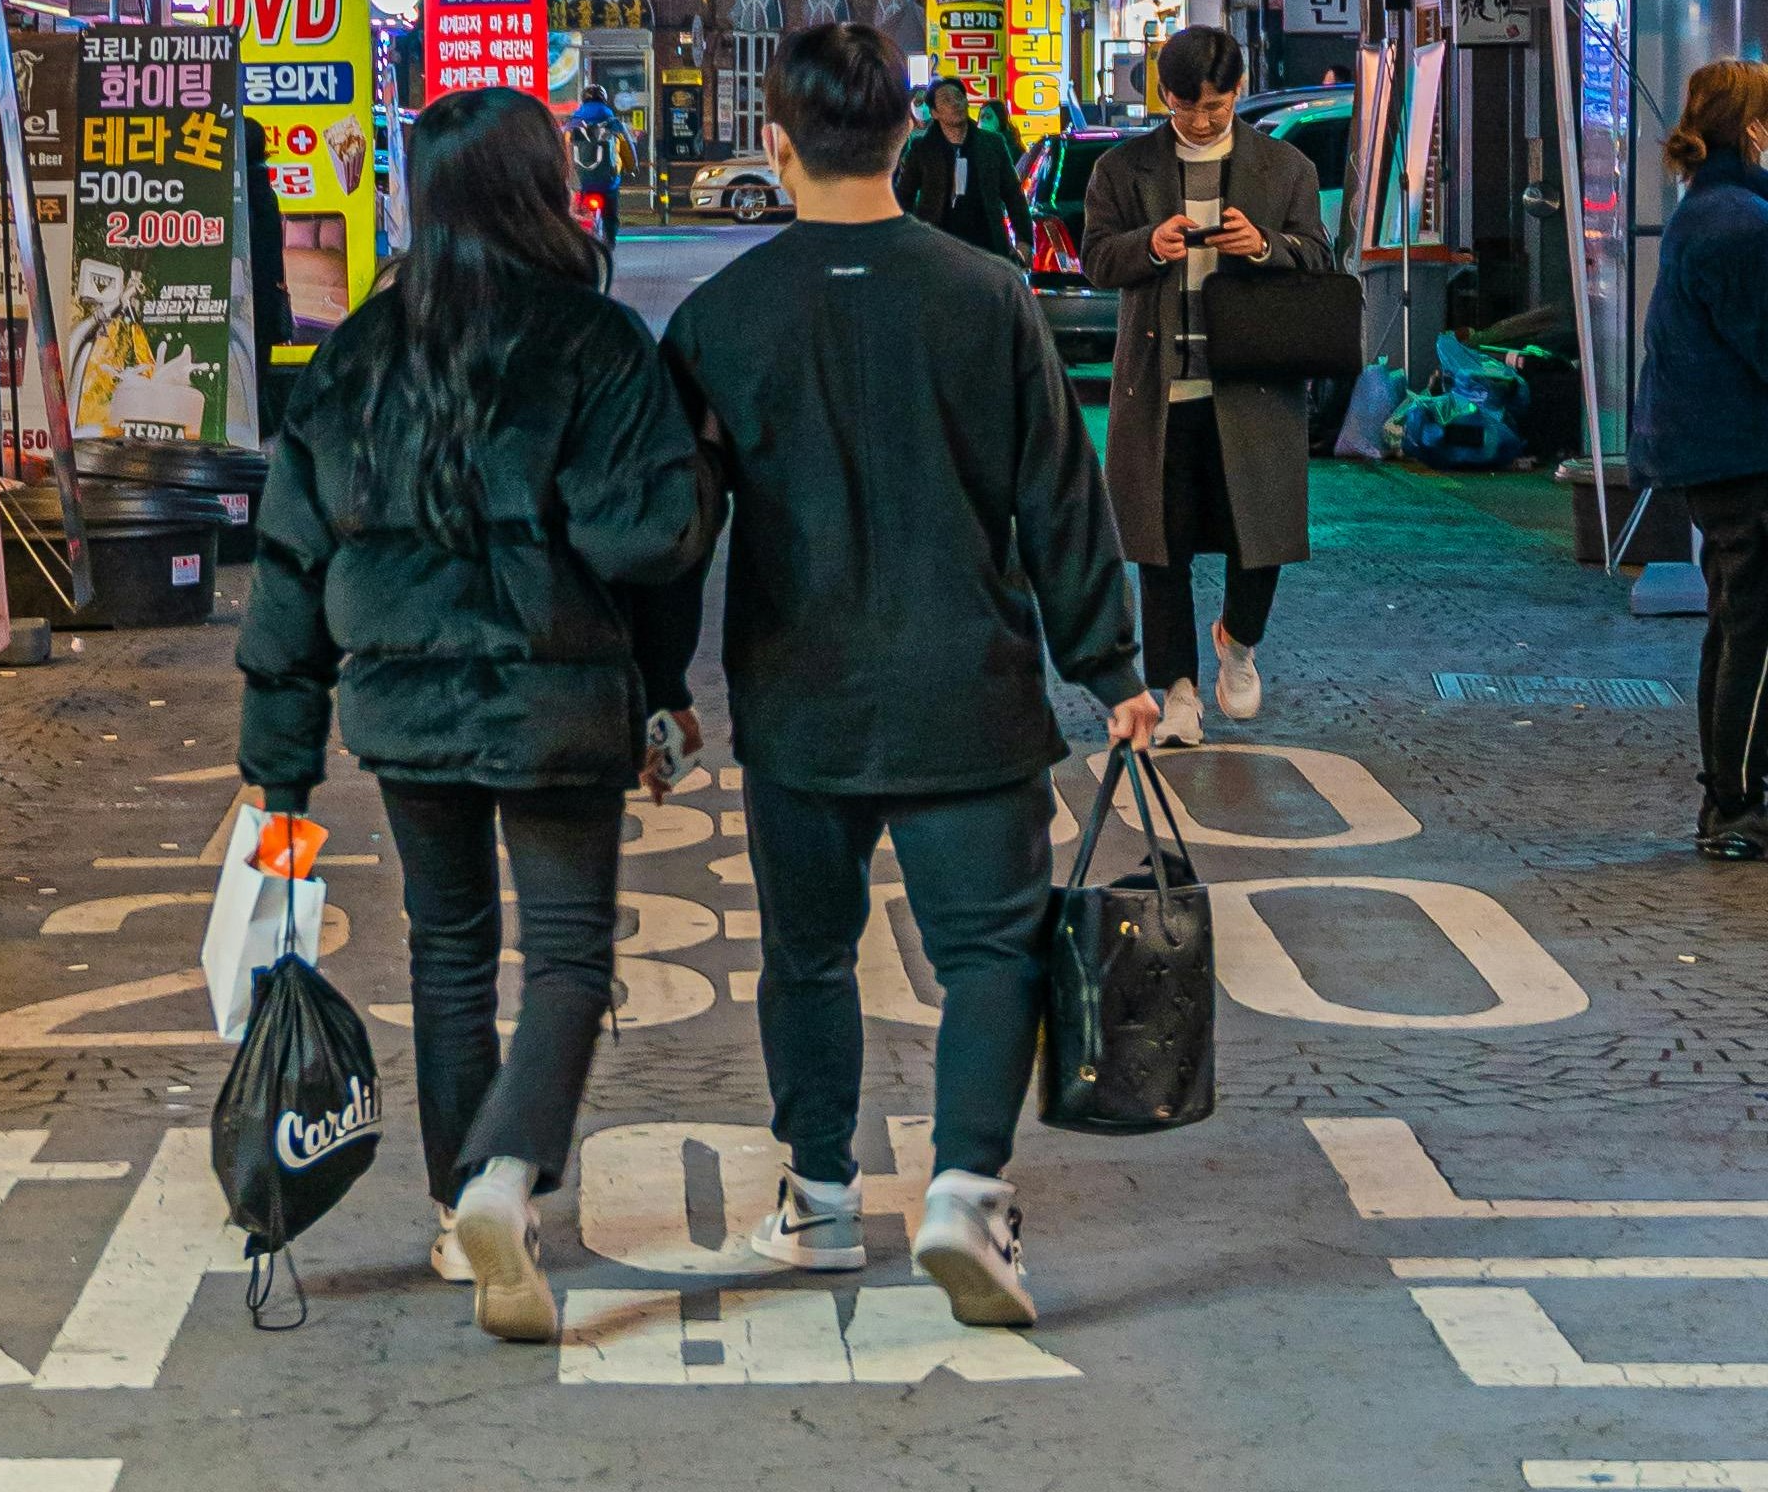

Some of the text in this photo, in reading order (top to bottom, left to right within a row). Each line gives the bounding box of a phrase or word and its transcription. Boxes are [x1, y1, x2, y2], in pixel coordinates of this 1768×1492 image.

[438, 13, 482, 36] 세계과자
[82, 34, 233, 64] 코로나 이겨내자
[438, 39, 482, 61] 인기안주
[100, 63, 213, 109] 화이팅
[242, 64, 339, 104] 동의자
[439, 66, 500, 88] 세계주류
[83, 115, 172, 167] 테라
[78, 170, 185, 205] 500cc
[105, 209, 225, 248] 2,000원
